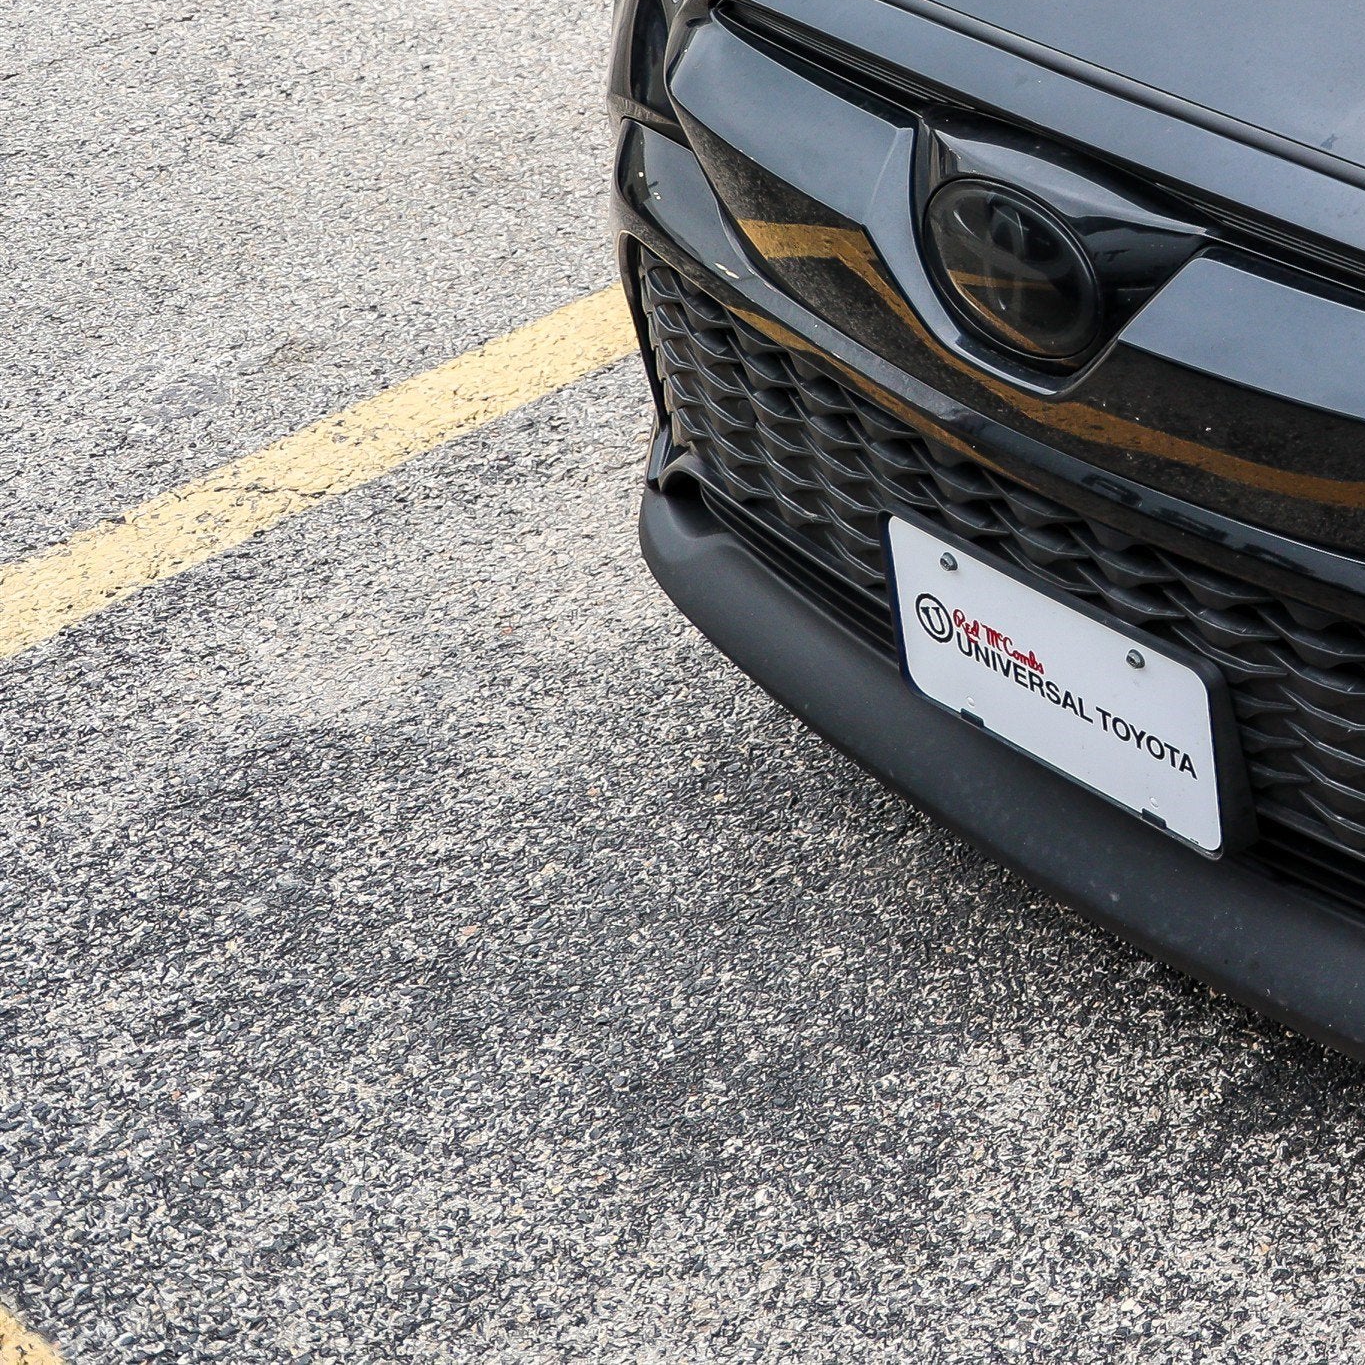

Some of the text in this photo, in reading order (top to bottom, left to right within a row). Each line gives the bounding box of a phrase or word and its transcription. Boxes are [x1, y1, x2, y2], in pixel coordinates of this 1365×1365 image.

[952, 608, 981, 644] Red
[955, 630, 1199, 780] UNIVERSAL TOYOTA
